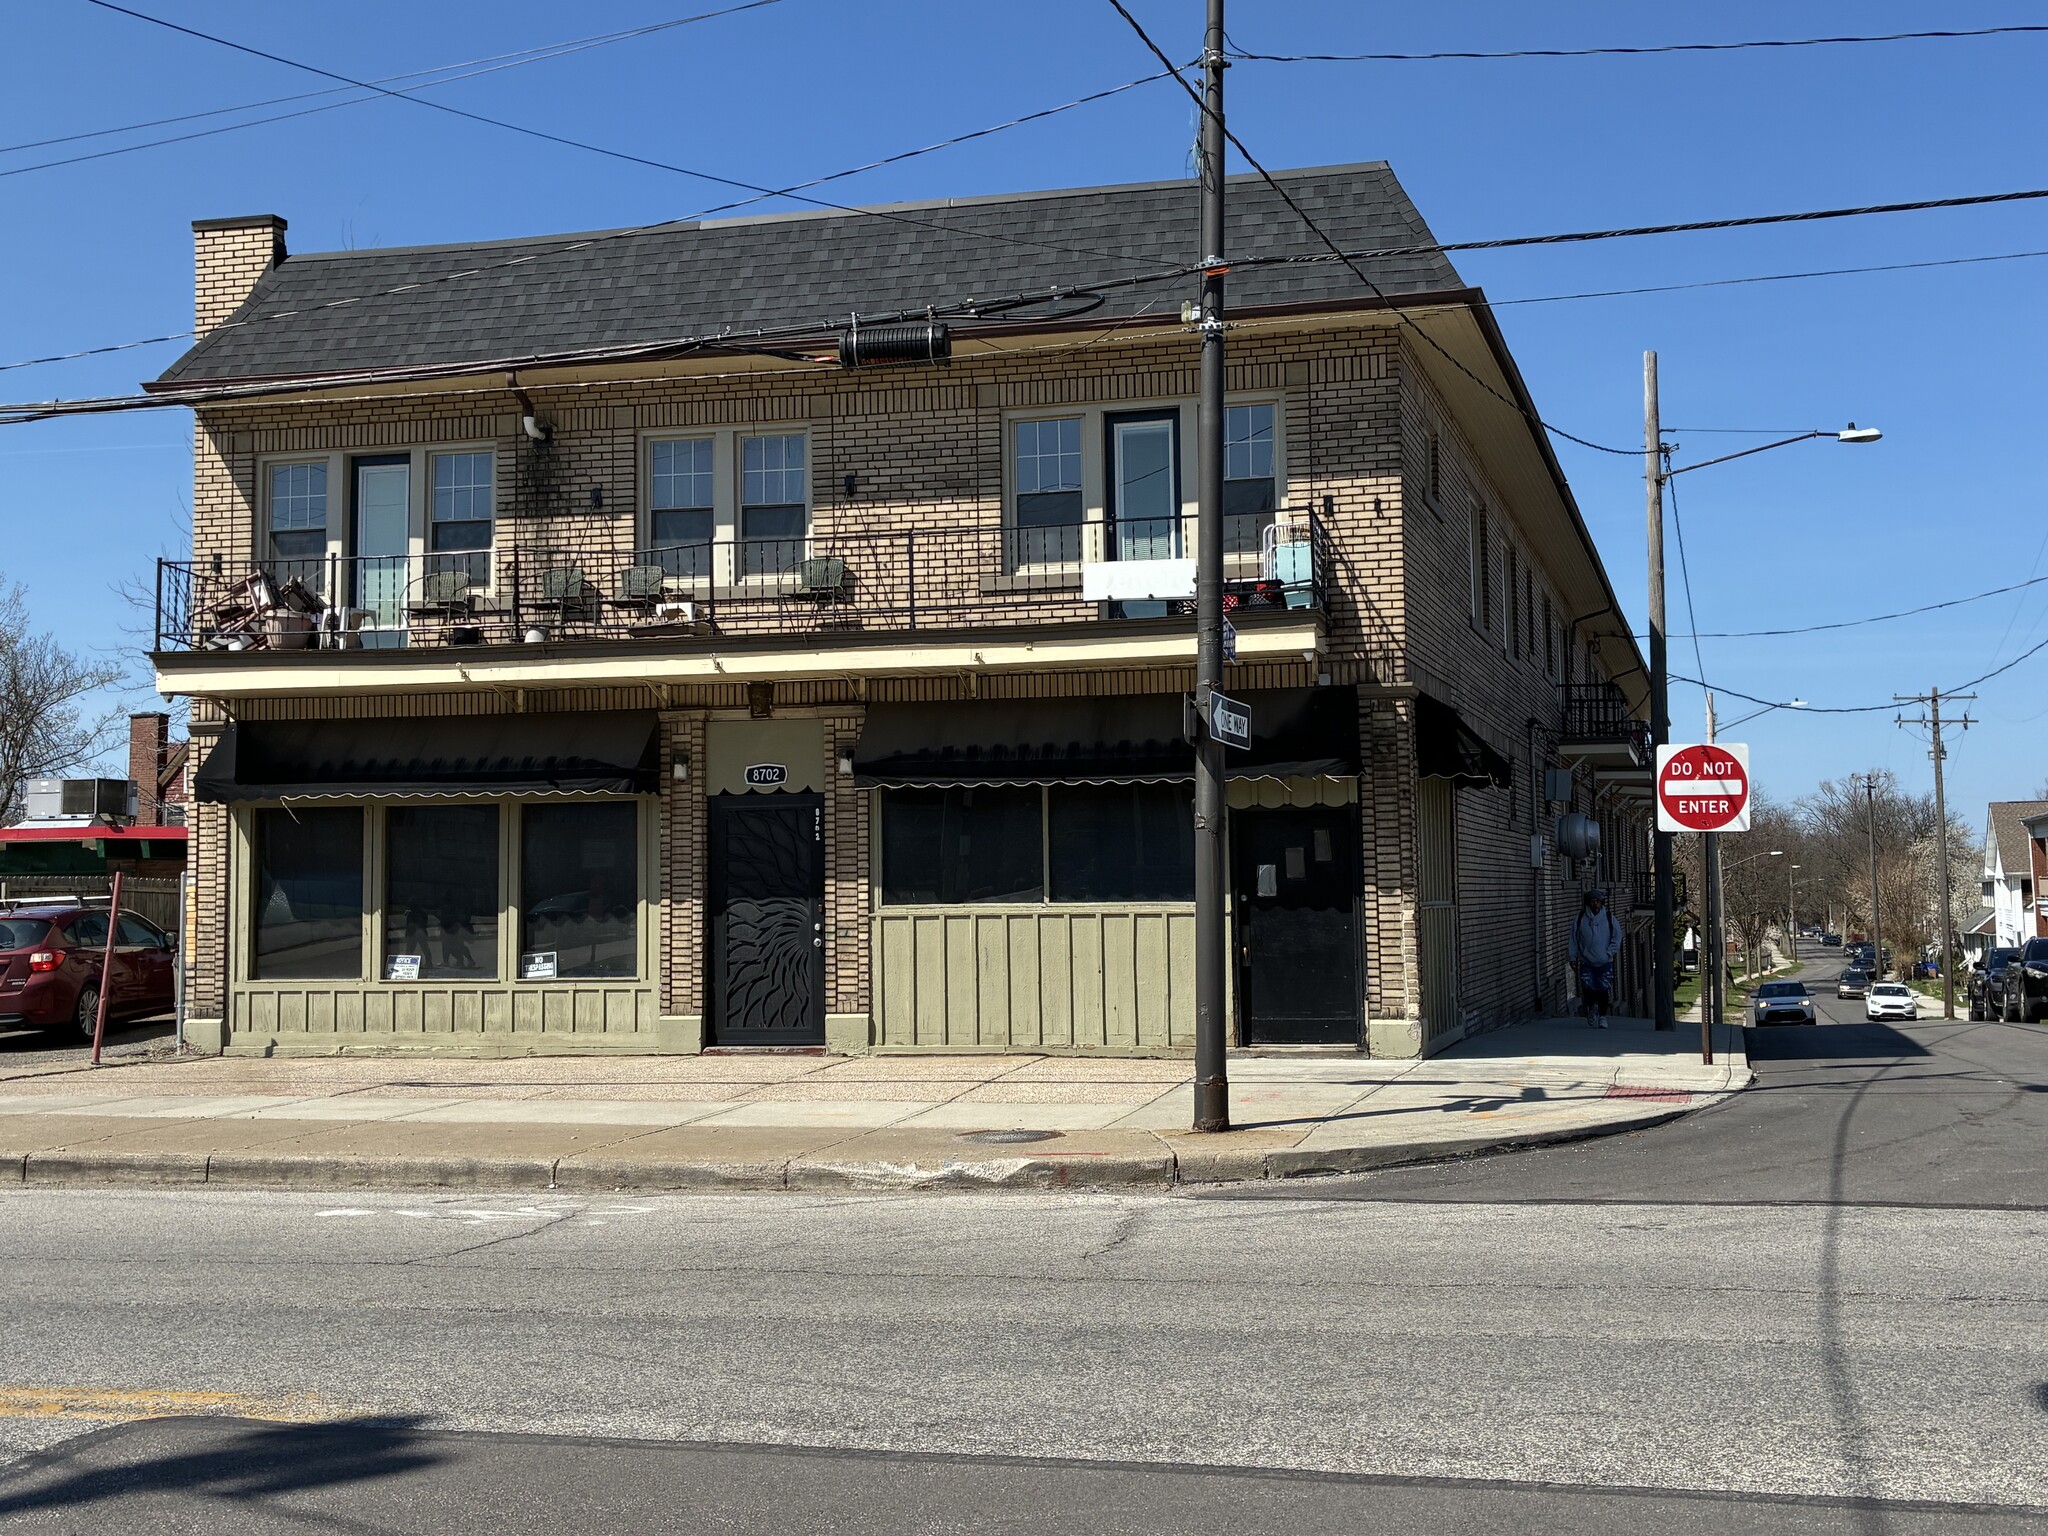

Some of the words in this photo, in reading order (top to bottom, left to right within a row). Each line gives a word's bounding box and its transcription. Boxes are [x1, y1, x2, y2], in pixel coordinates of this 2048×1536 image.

[1221, 710, 1232, 731] ONE
[1233, 715, 1246, 735] WAY
[753, 769, 780, 781] 8702
[1671, 762, 1692, 775] DO
[1703, 762, 1734, 775] NOT
[1679, 800, 1729, 814] ENTER
[534, 956, 544, 964] NO
